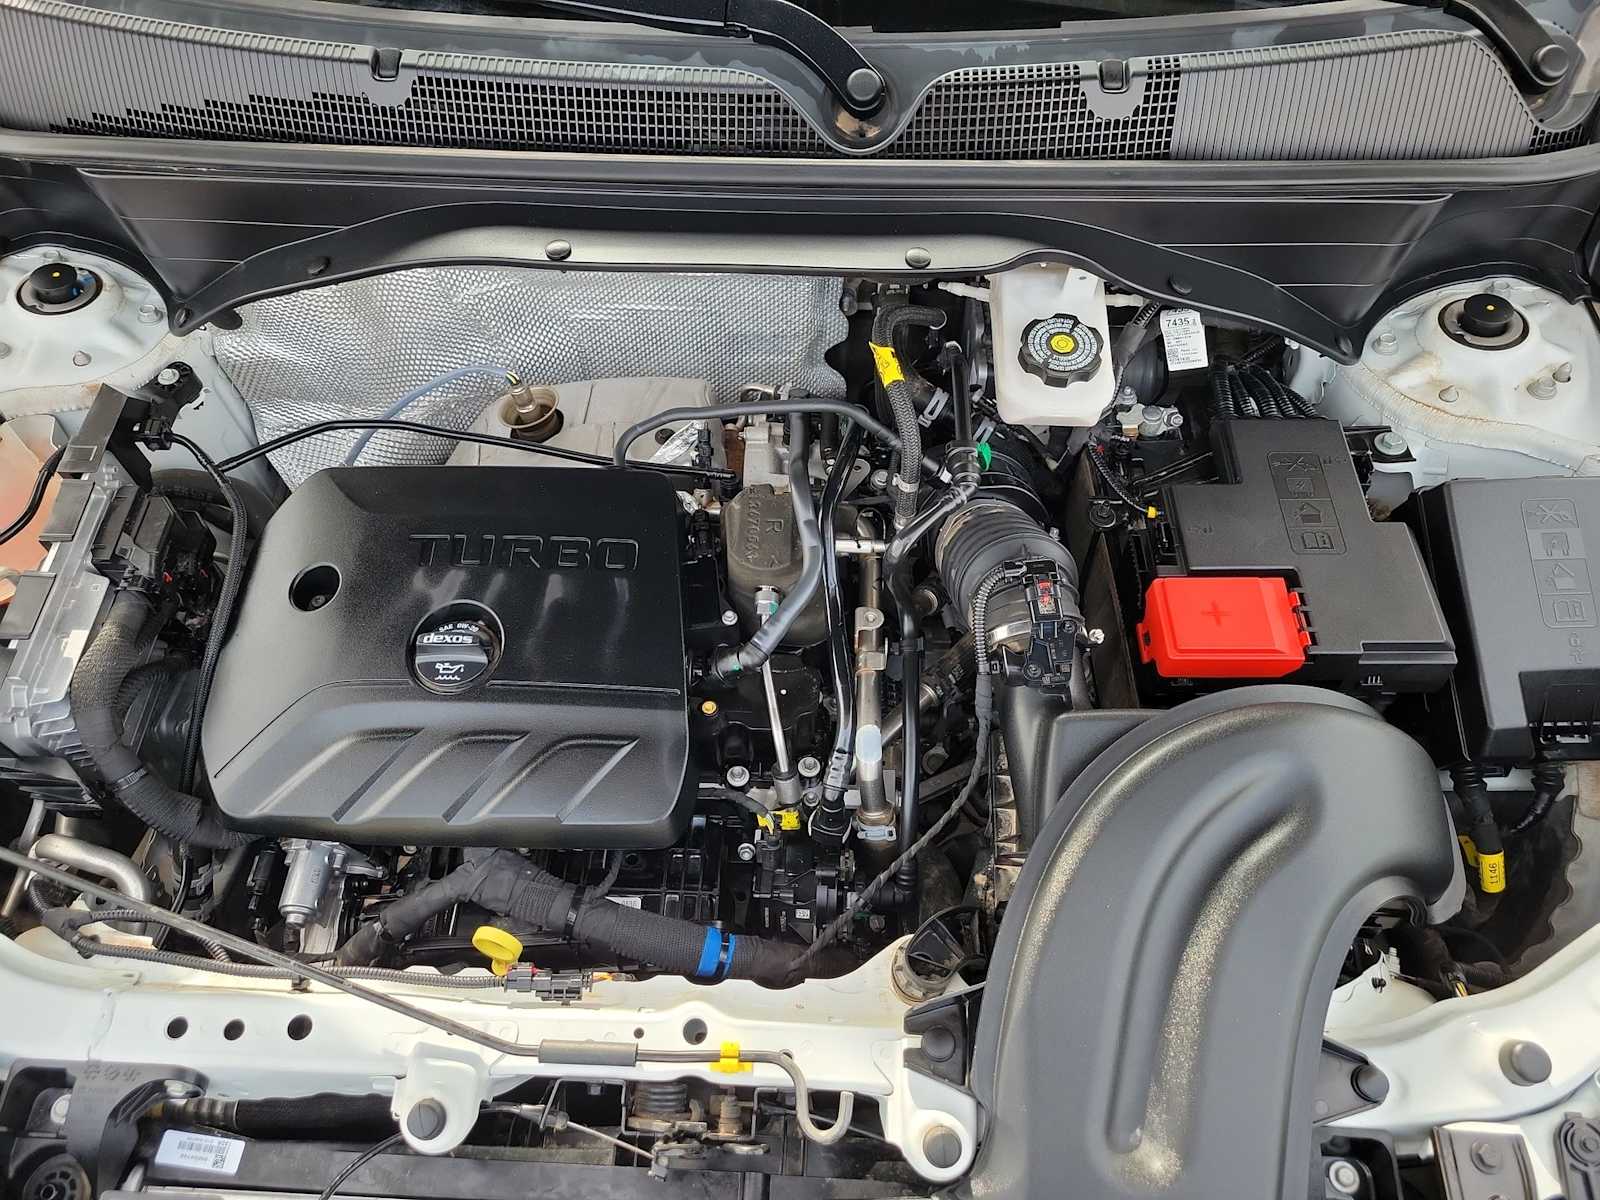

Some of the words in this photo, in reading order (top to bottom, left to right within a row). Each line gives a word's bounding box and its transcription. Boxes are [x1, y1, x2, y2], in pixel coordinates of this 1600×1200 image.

[408, 534, 640, 571] TURBO
[438, 623, 454, 633] SAE
[423, 632, 473, 644] dexos
